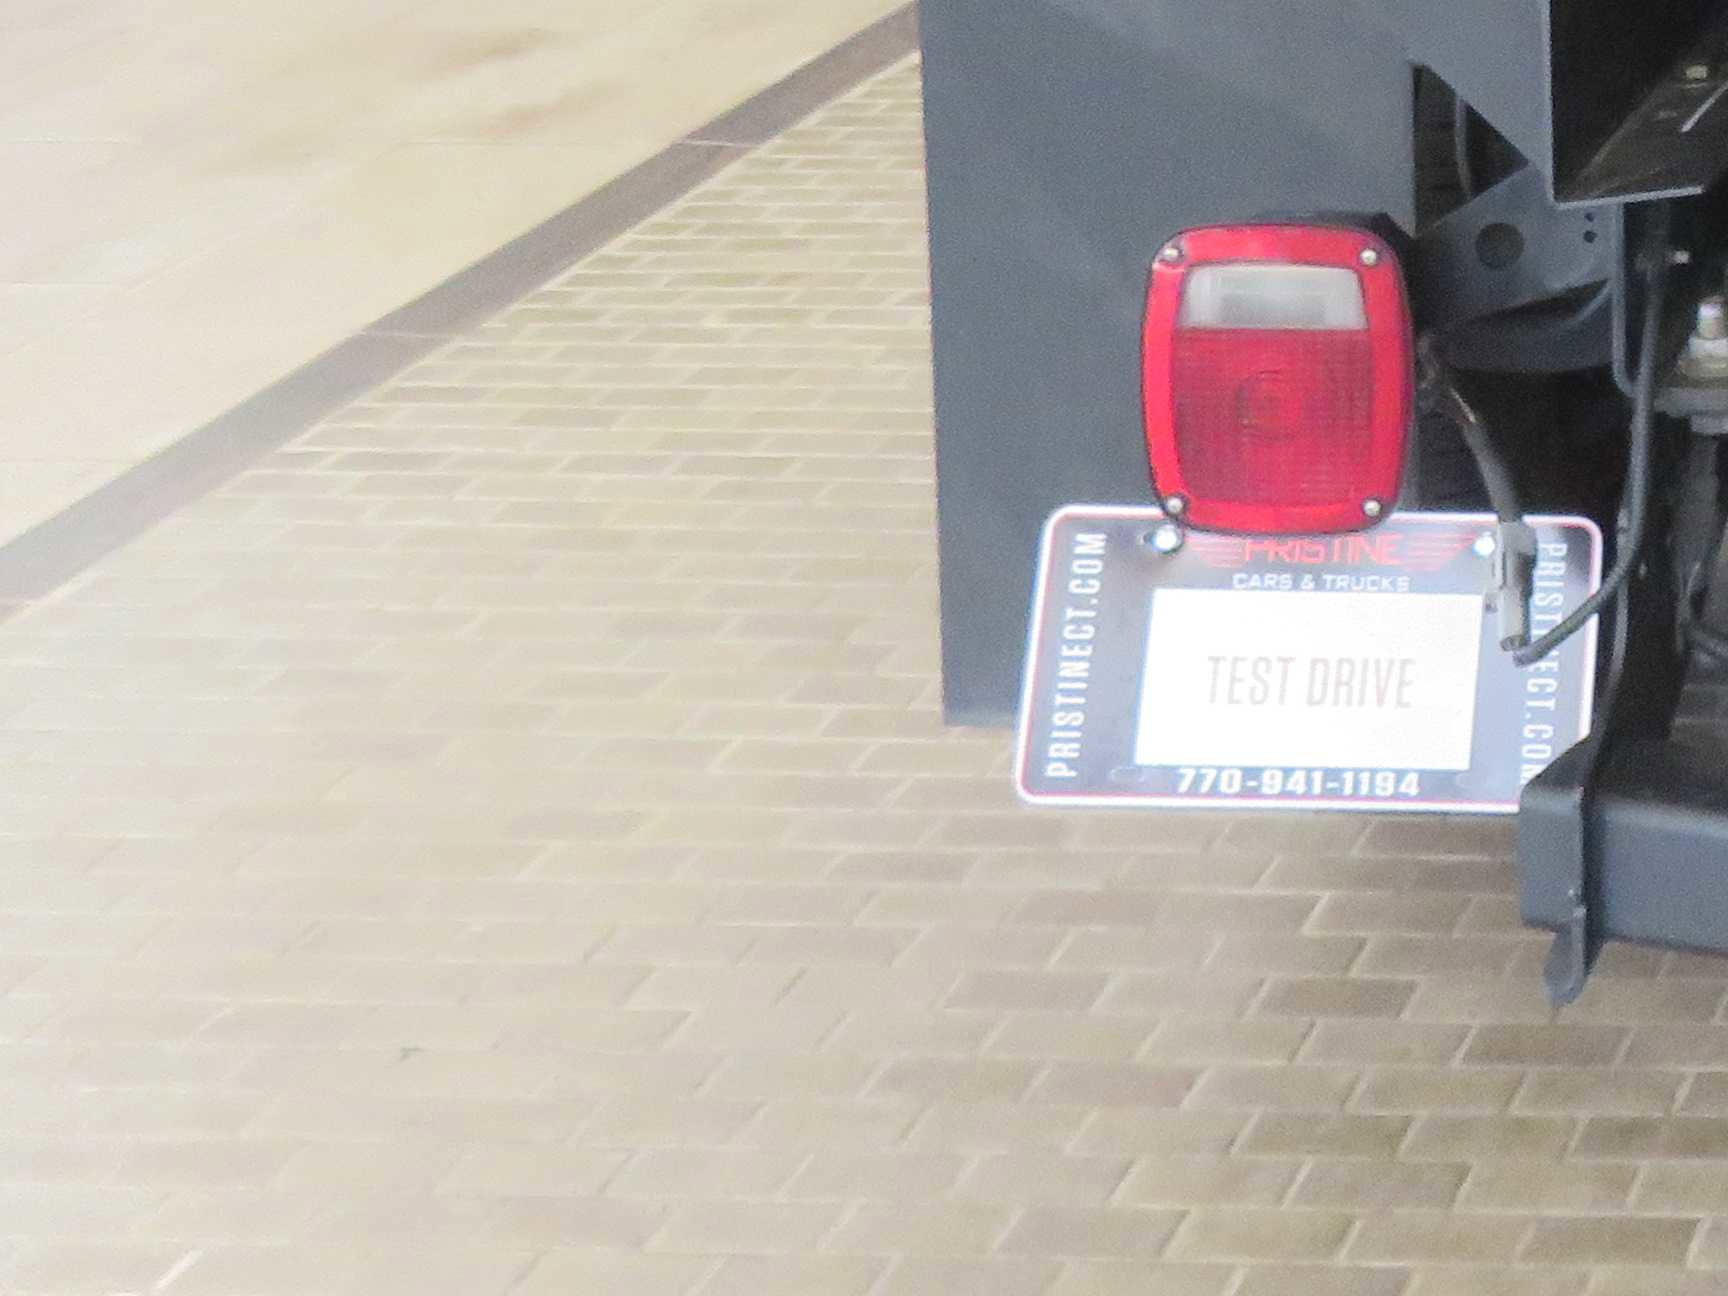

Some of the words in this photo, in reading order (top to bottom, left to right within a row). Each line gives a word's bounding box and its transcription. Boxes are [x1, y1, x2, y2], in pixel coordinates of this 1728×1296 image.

[1232, 573, 1293, 590] CARS
[1300, 574, 1315, 590] &
[1323, 574, 1410, 592] TRUCKS
[1045, 533, 1107, 777] PRISTINECT.COM
[1207, 656, 1296, 706] TEST
[1304, 657, 1416, 708] DRIVE
[1176, 767, 1421, 796] 770-941-1194
